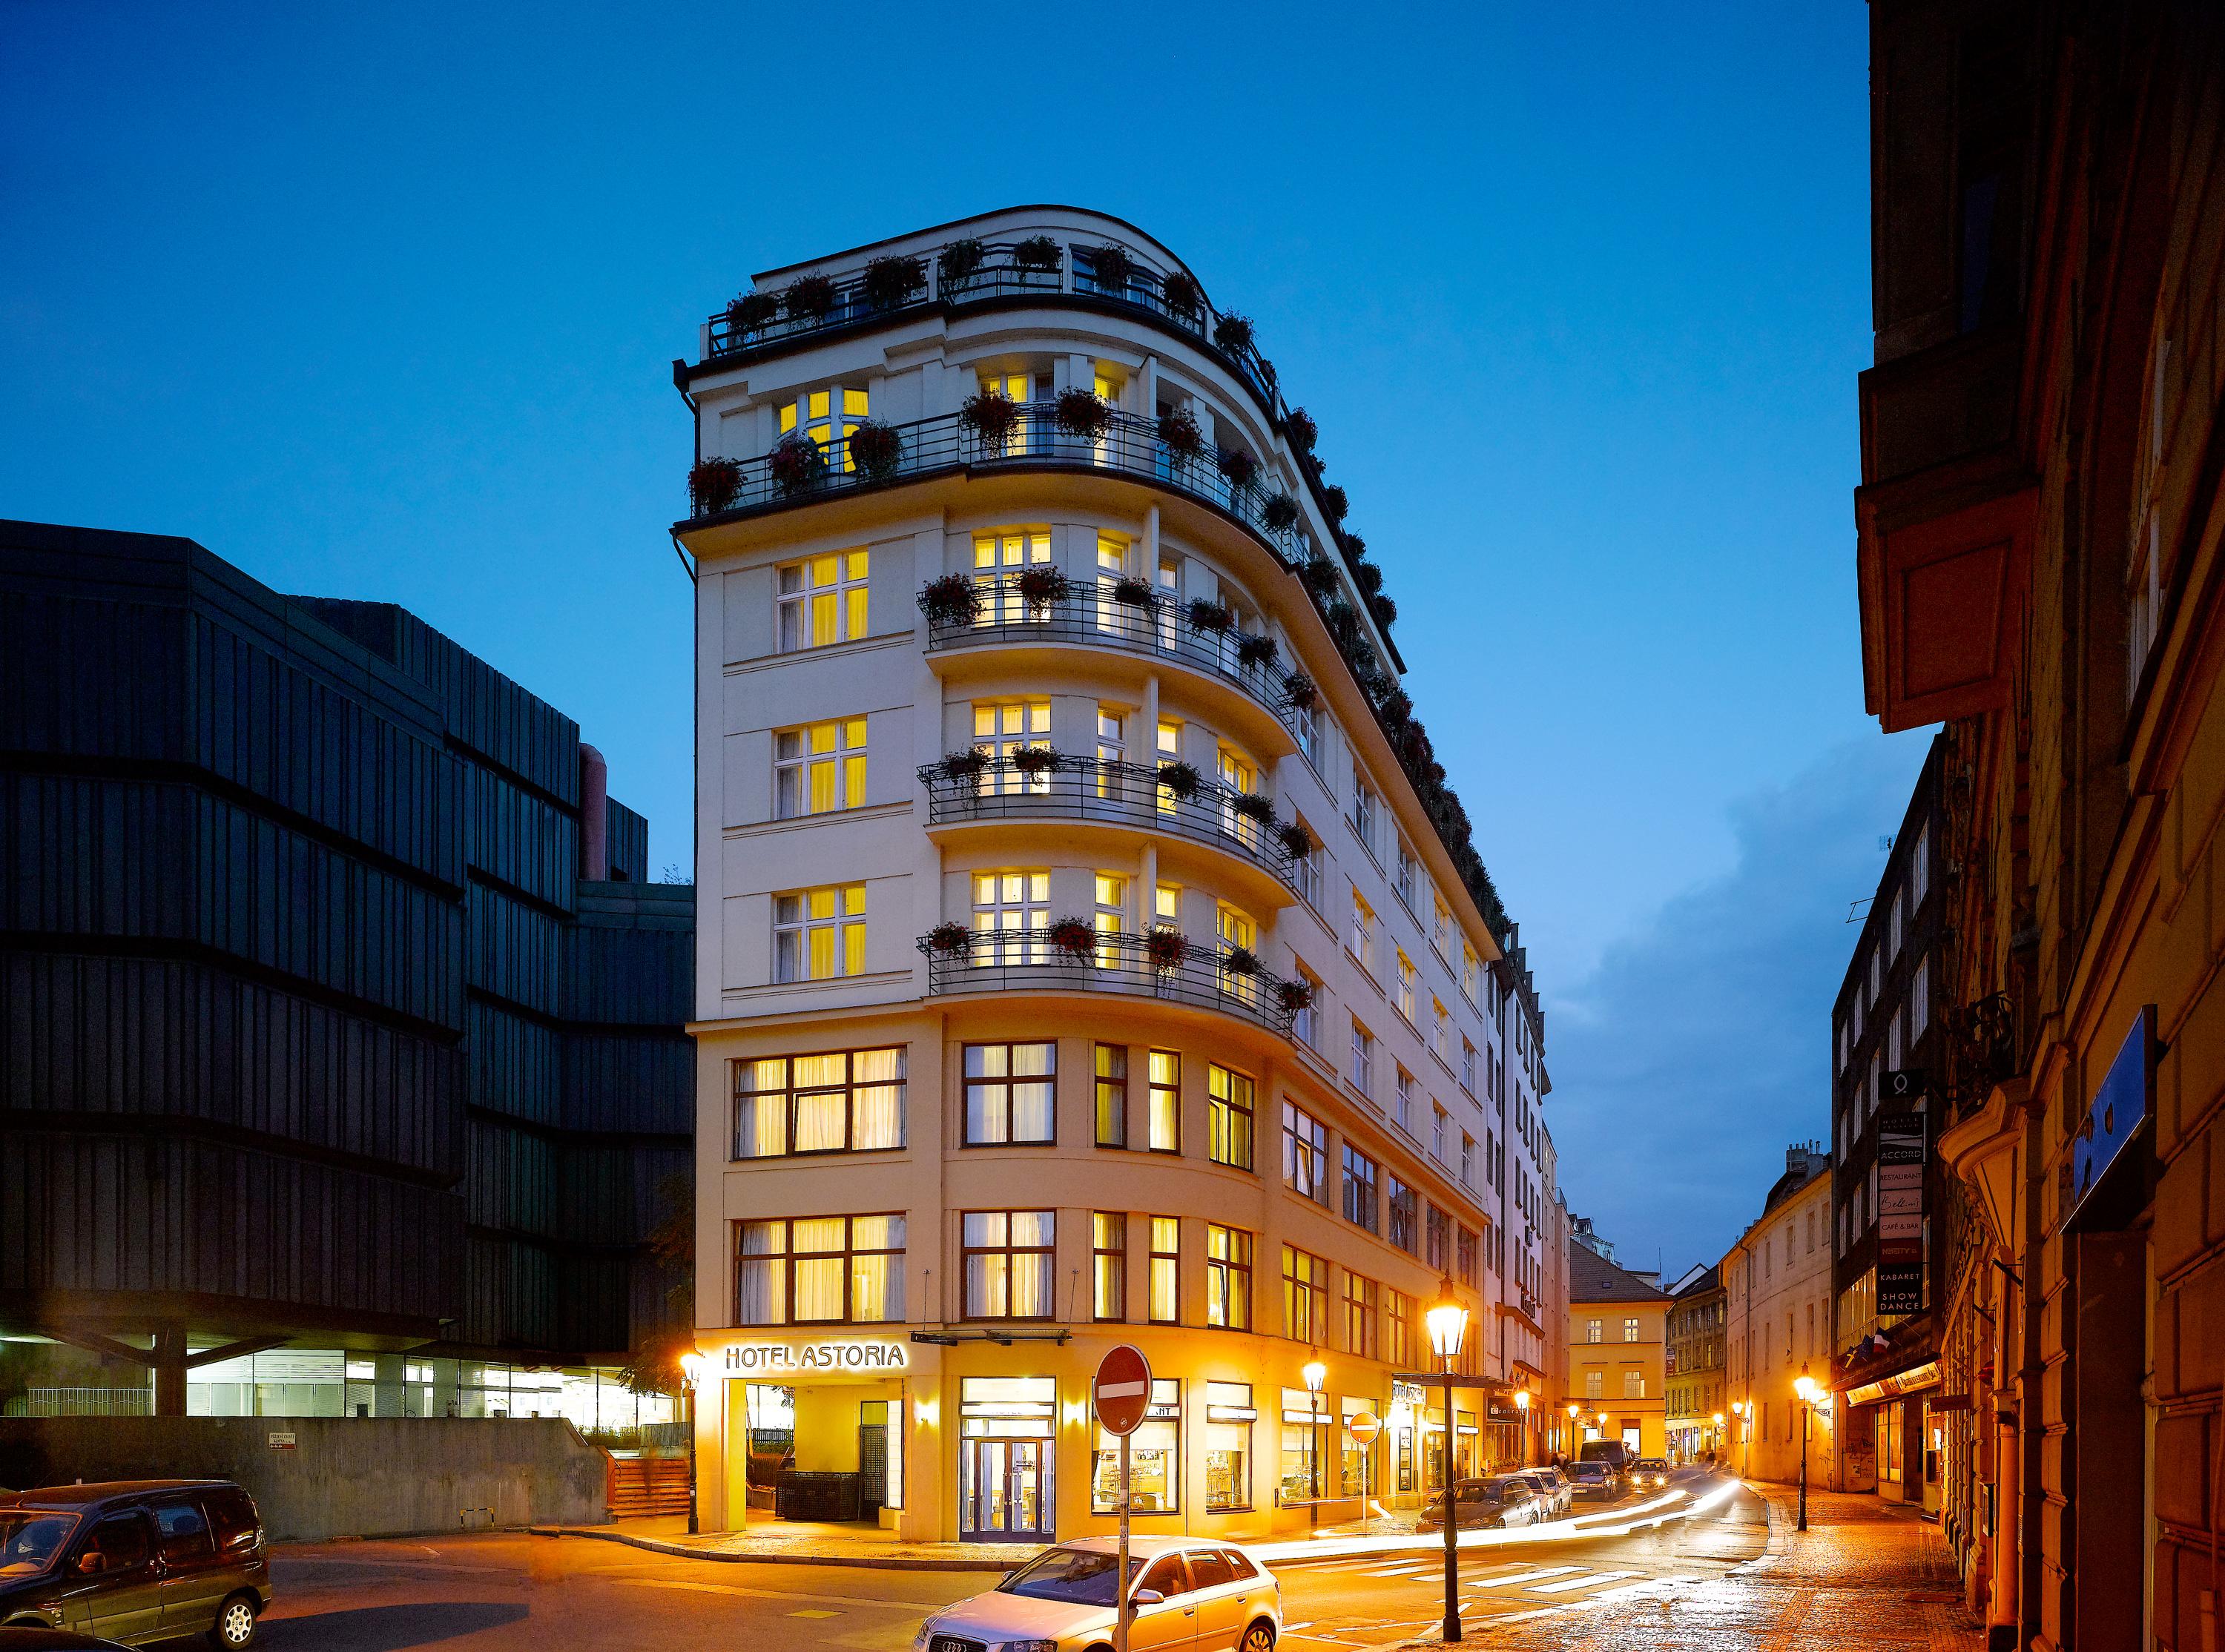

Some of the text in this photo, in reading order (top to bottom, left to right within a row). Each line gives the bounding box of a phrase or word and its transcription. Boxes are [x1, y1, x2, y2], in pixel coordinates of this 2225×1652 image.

[1881, 1150, 1922, 1160] ACCORD
[1879, 1172, 1921, 1181] RESTAURANT
[1882, 1222, 1899, 1230] CAFÉ
[1882, 1292, 1916, 1301] SHOW
[1880, 1302, 1919, 1311] DANCE
[726, 1344, 904, 1369] HOTEL ASTORIA
